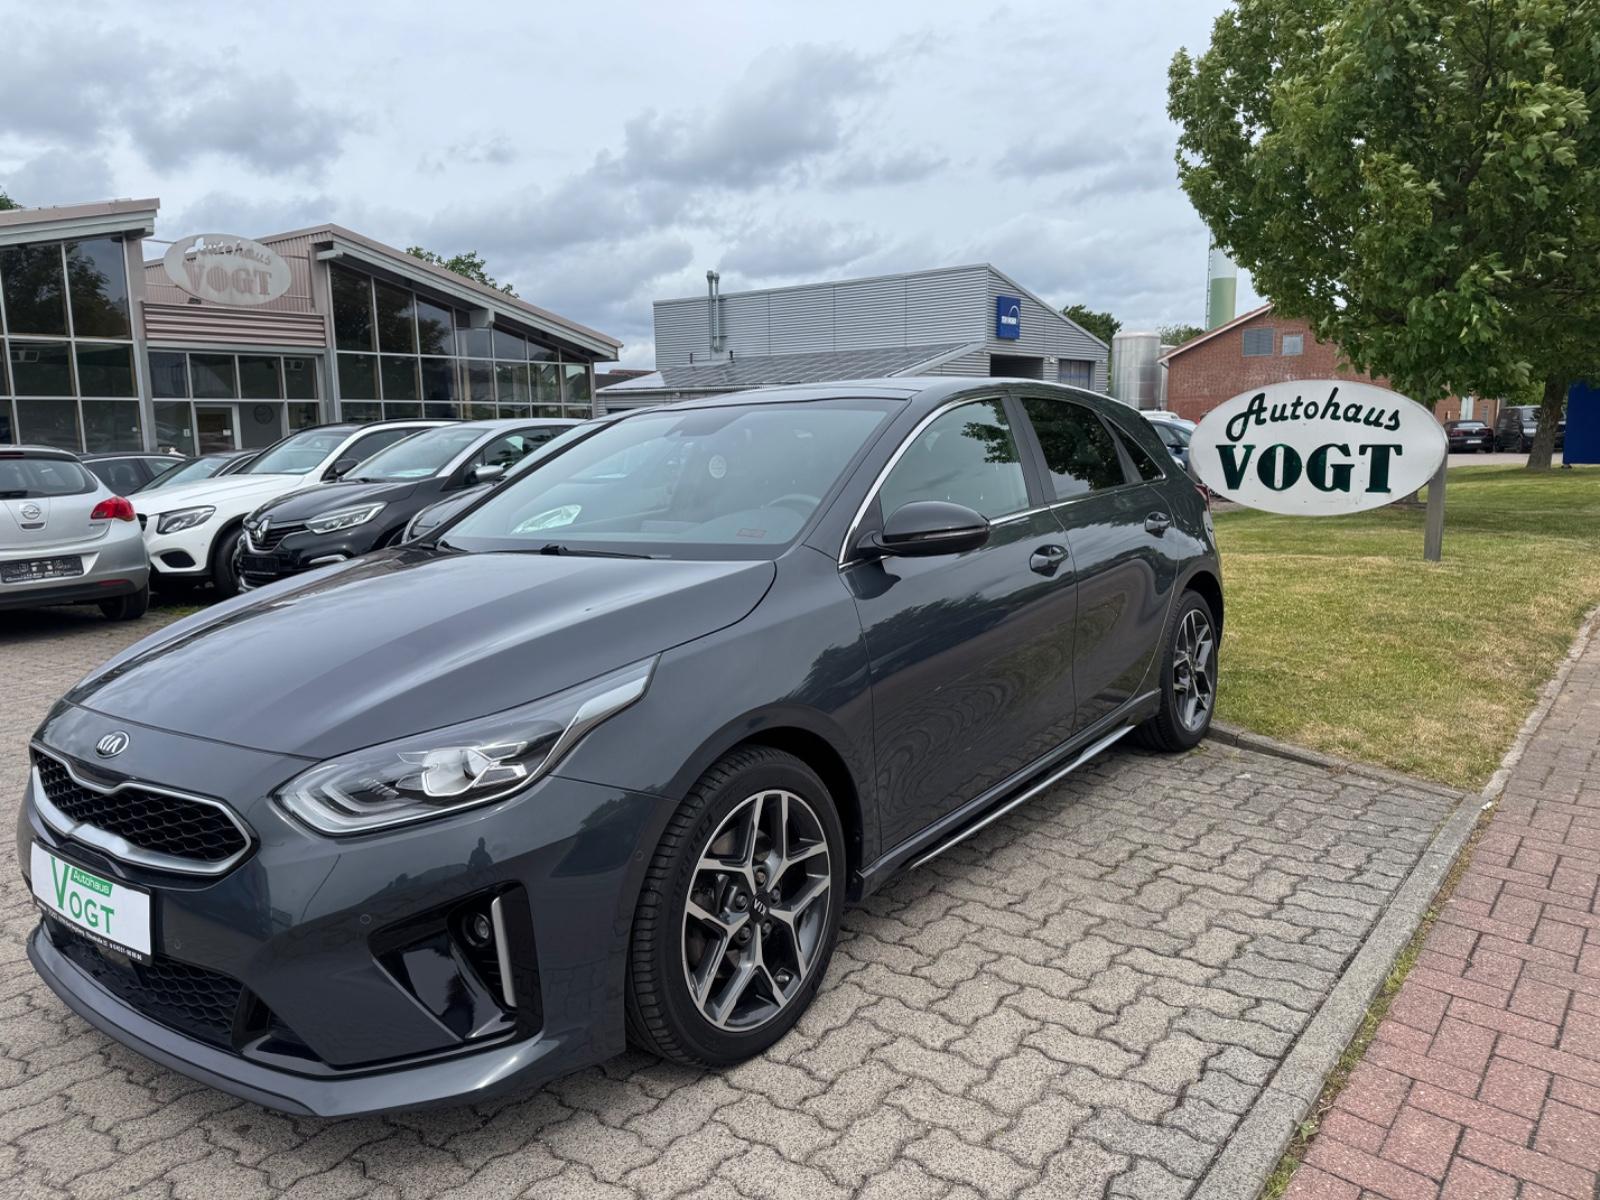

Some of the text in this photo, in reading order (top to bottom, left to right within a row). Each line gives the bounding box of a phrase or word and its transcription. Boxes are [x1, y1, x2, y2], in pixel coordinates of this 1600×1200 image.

[181, 260, 272, 296] VOGT
[1225, 387, 1400, 442] Autohaus
[1215, 443, 1403, 493] VOGT
[97, 735, 122, 753] KIA
[50, 856, 114, 934] VOGT
[73, 870, 110, 894] Autohaus
